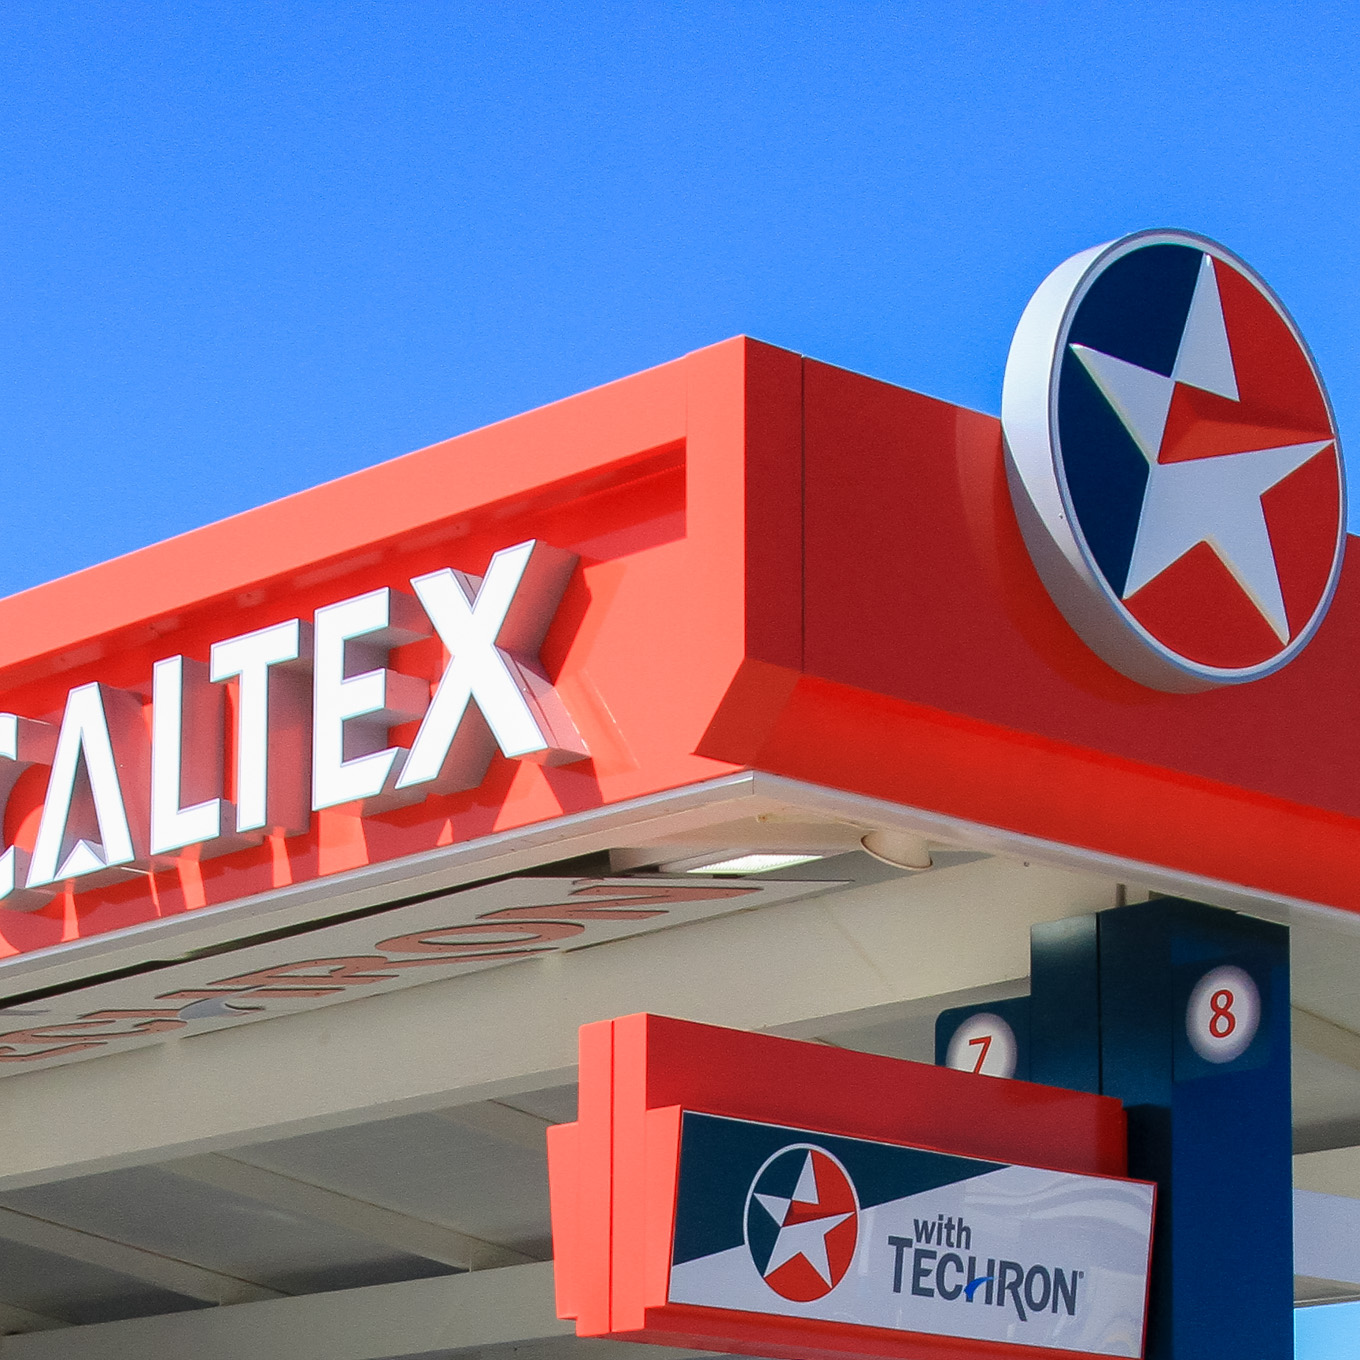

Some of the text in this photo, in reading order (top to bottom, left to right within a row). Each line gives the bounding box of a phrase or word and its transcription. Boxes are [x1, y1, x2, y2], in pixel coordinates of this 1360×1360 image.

[1209, 989, 1236, 1039] 8
[969, 1035, 992, 1075] 7
[913, 1214, 972, 1250] with
[888, 1235, 1080, 1322] TECHRON
